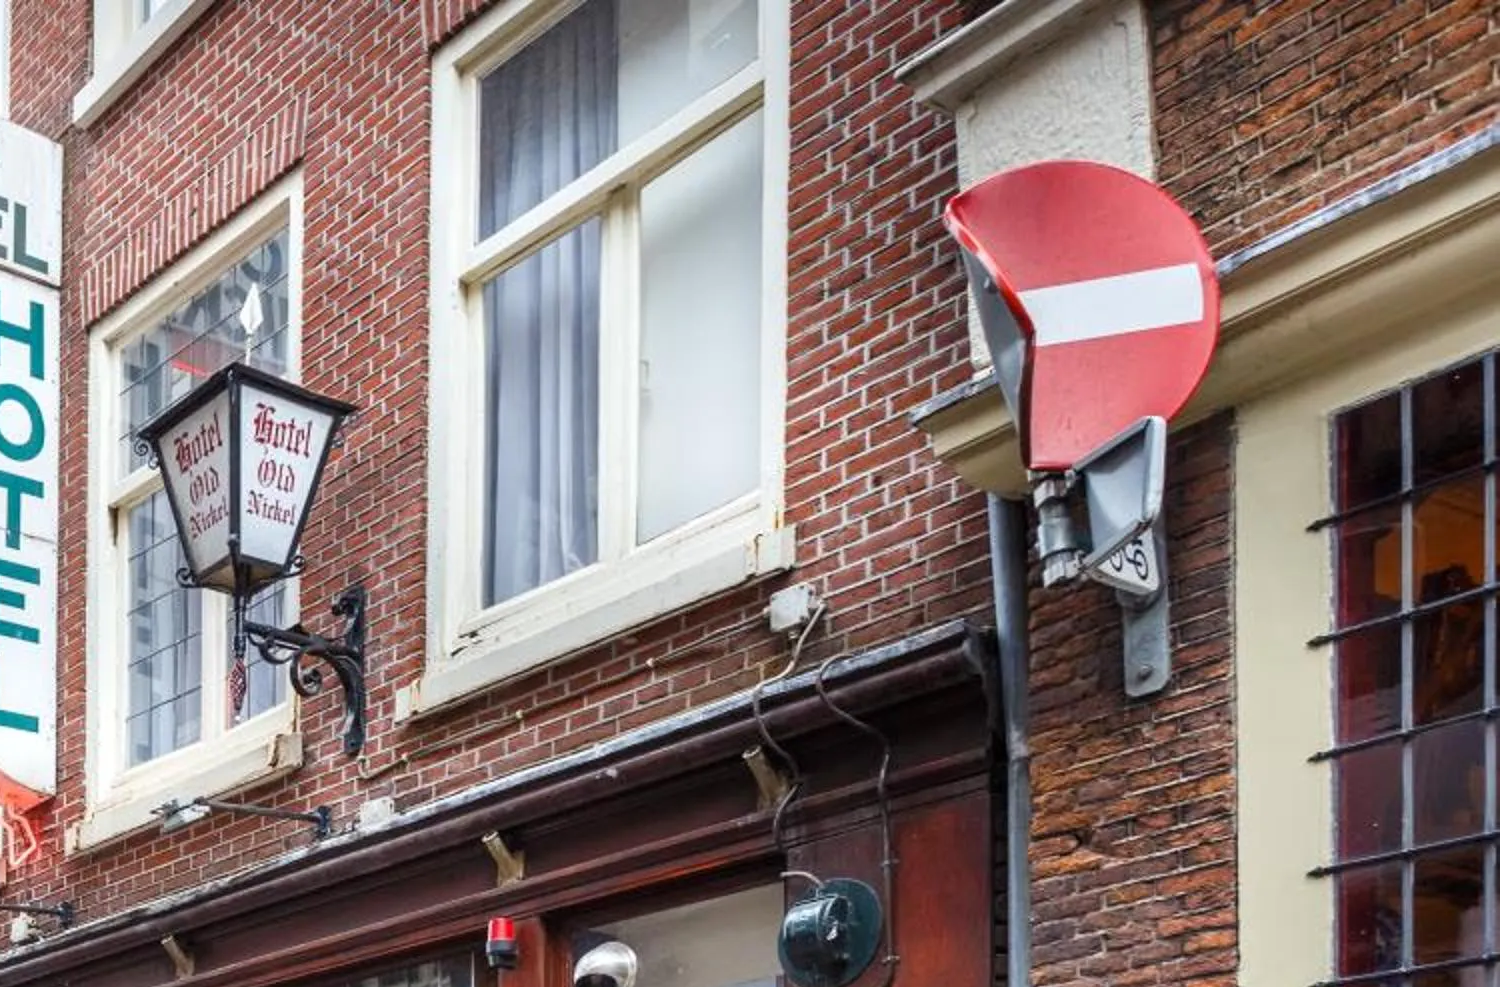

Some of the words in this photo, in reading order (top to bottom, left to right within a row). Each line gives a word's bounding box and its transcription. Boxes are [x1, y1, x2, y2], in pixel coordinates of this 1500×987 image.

[174, 412, 223, 475] Hotel
[254, 403, 313, 459] Hotel
[190, 466, 220, 506] Old
[258, 456, 295, 492] Old
[190, 496, 229, 540] Nickel
[246, 490, 296, 526] Nickel
